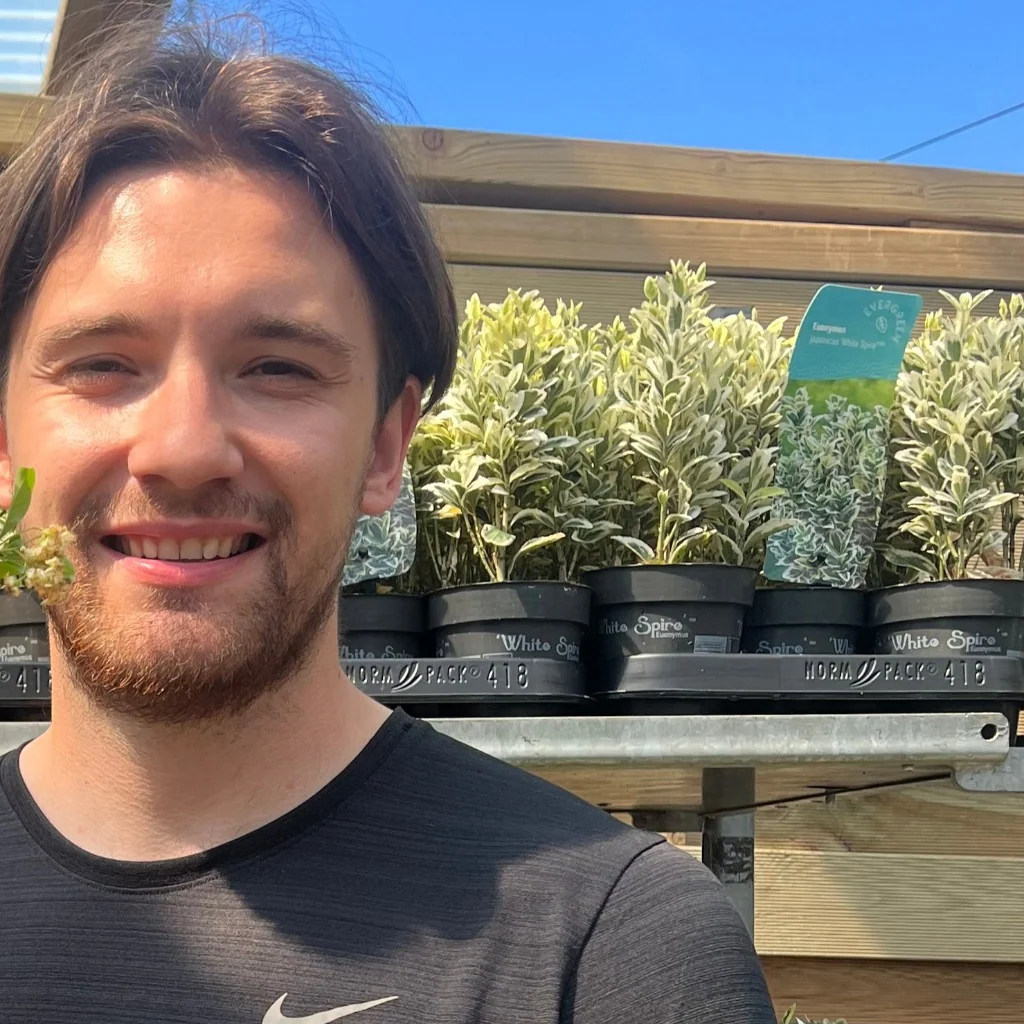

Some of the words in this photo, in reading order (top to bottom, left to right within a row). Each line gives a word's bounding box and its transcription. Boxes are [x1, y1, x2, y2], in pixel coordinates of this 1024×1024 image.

[16, 667, 52, 694] 41
[487, 662, 529, 690] 418
[804, 659, 853, 681] NORM
[944, 658, 986, 687] 418
